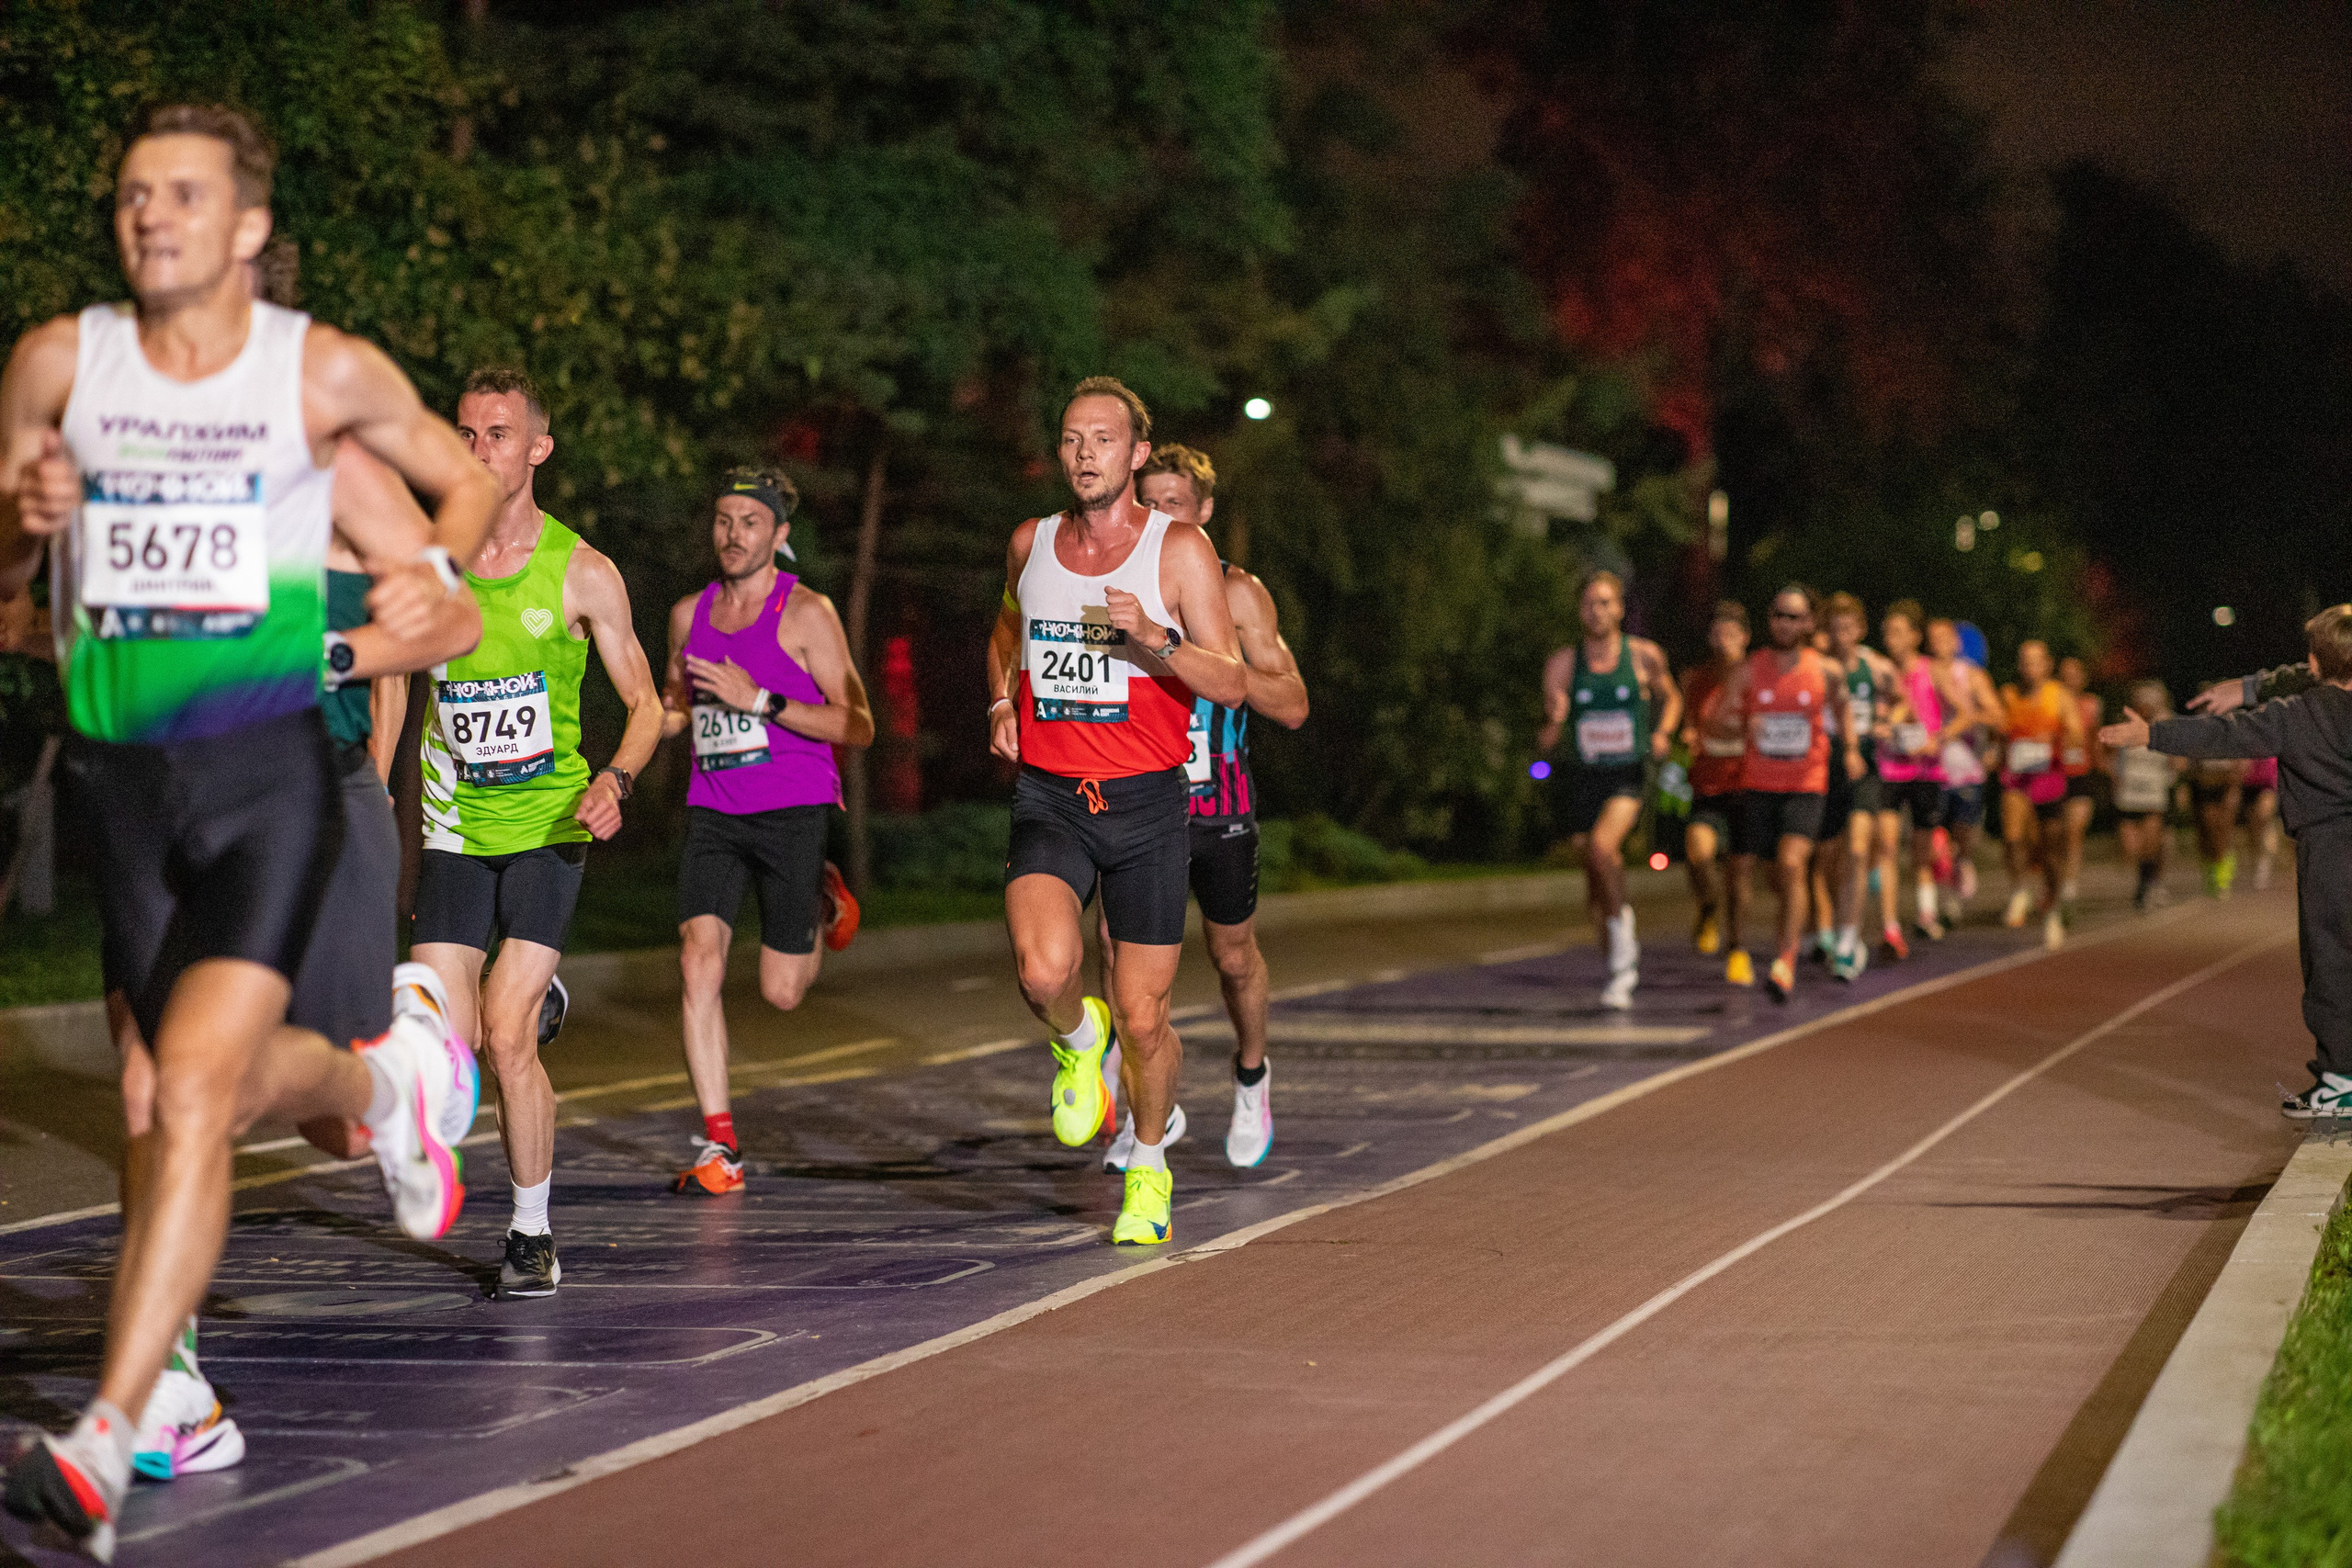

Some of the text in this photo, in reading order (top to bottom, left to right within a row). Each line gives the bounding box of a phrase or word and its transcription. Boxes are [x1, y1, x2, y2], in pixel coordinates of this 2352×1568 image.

[108, 522, 238, 571] 5678
[1041, 650, 1110, 683] 2401
[1053, 683, 1099, 695] ВАСИЛИЙ
[452, 705, 537, 745] 8749
[699, 711, 752, 739] 2616
[476, 743, 519, 756] ЭДУАРД
